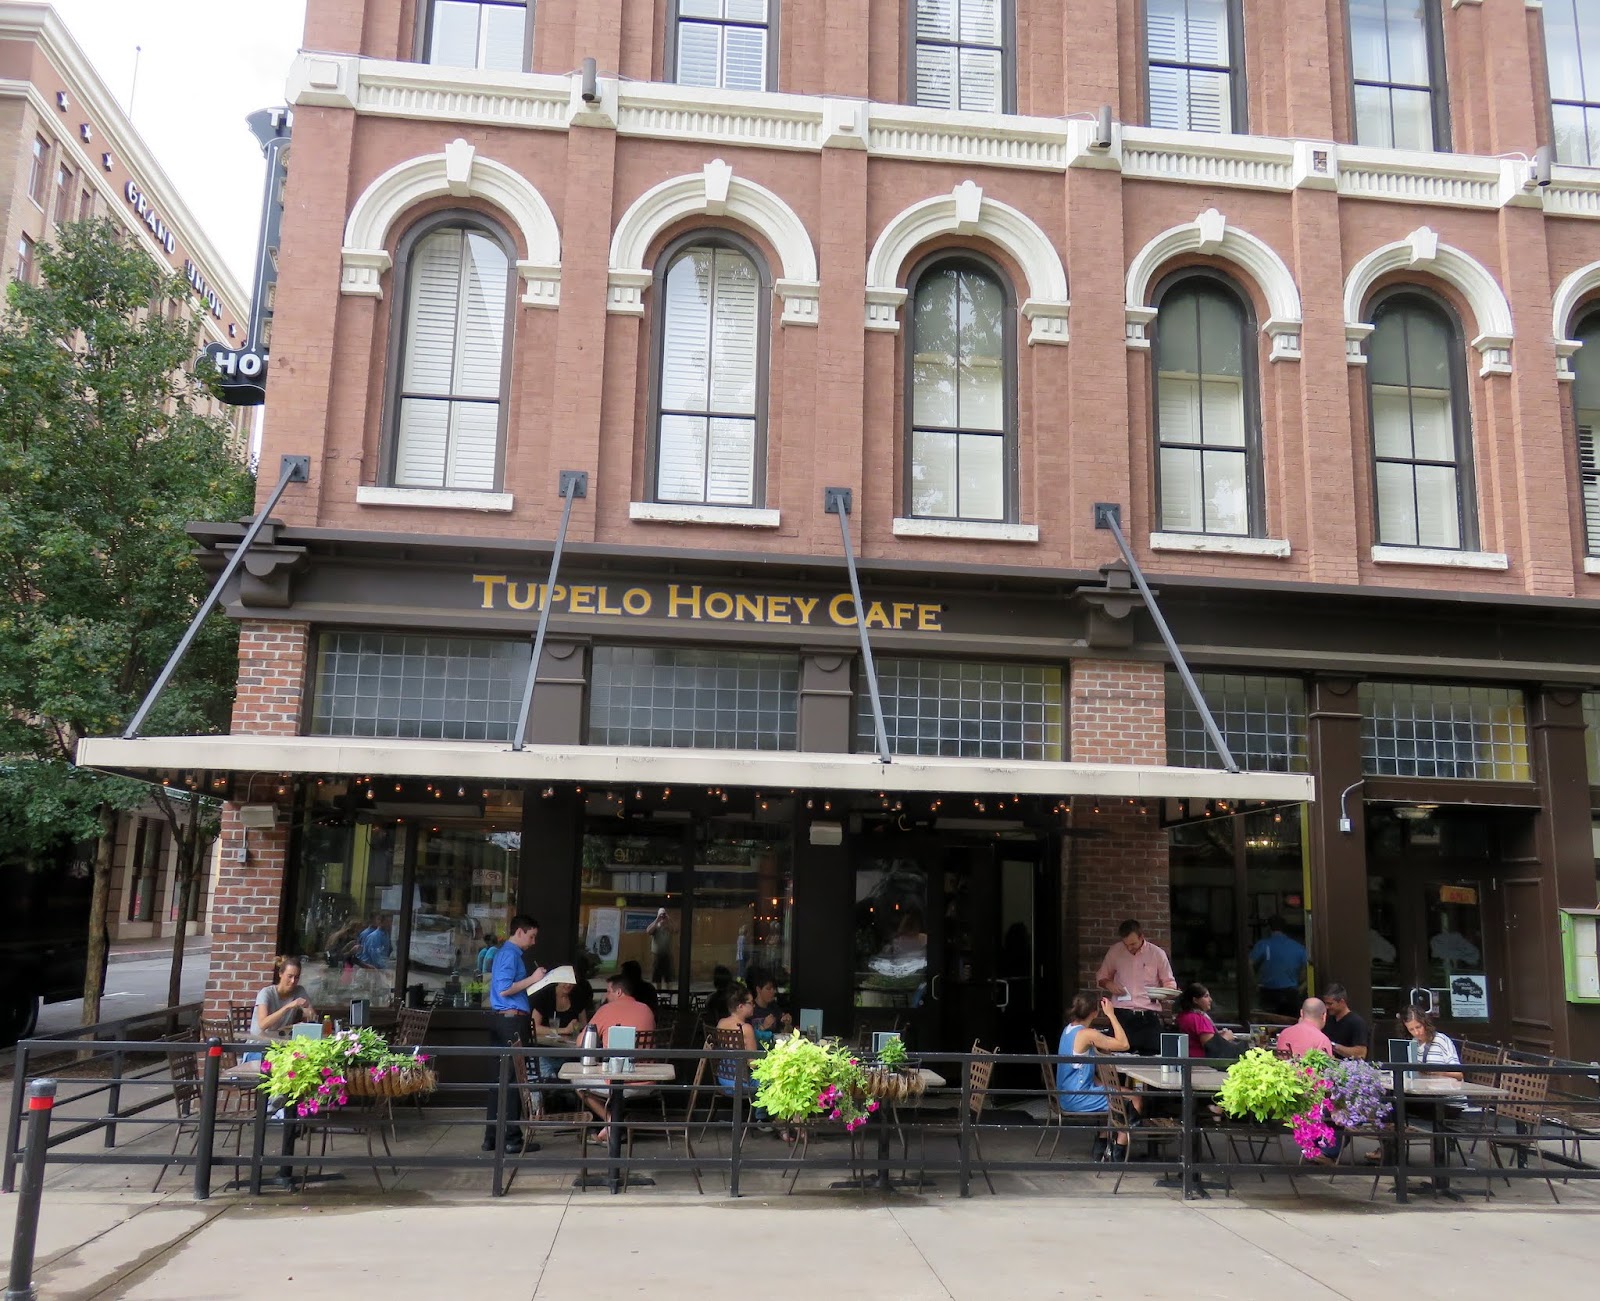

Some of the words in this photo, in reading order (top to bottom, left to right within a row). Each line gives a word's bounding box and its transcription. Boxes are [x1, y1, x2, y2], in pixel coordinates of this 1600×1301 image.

[125, 180, 176, 255] GRAND
[185, 259, 222, 320] UNION
[472, 574, 652, 617] TUPELO
[667, 584, 819, 625] HONEY
[828, 593, 943, 632] CAFE
